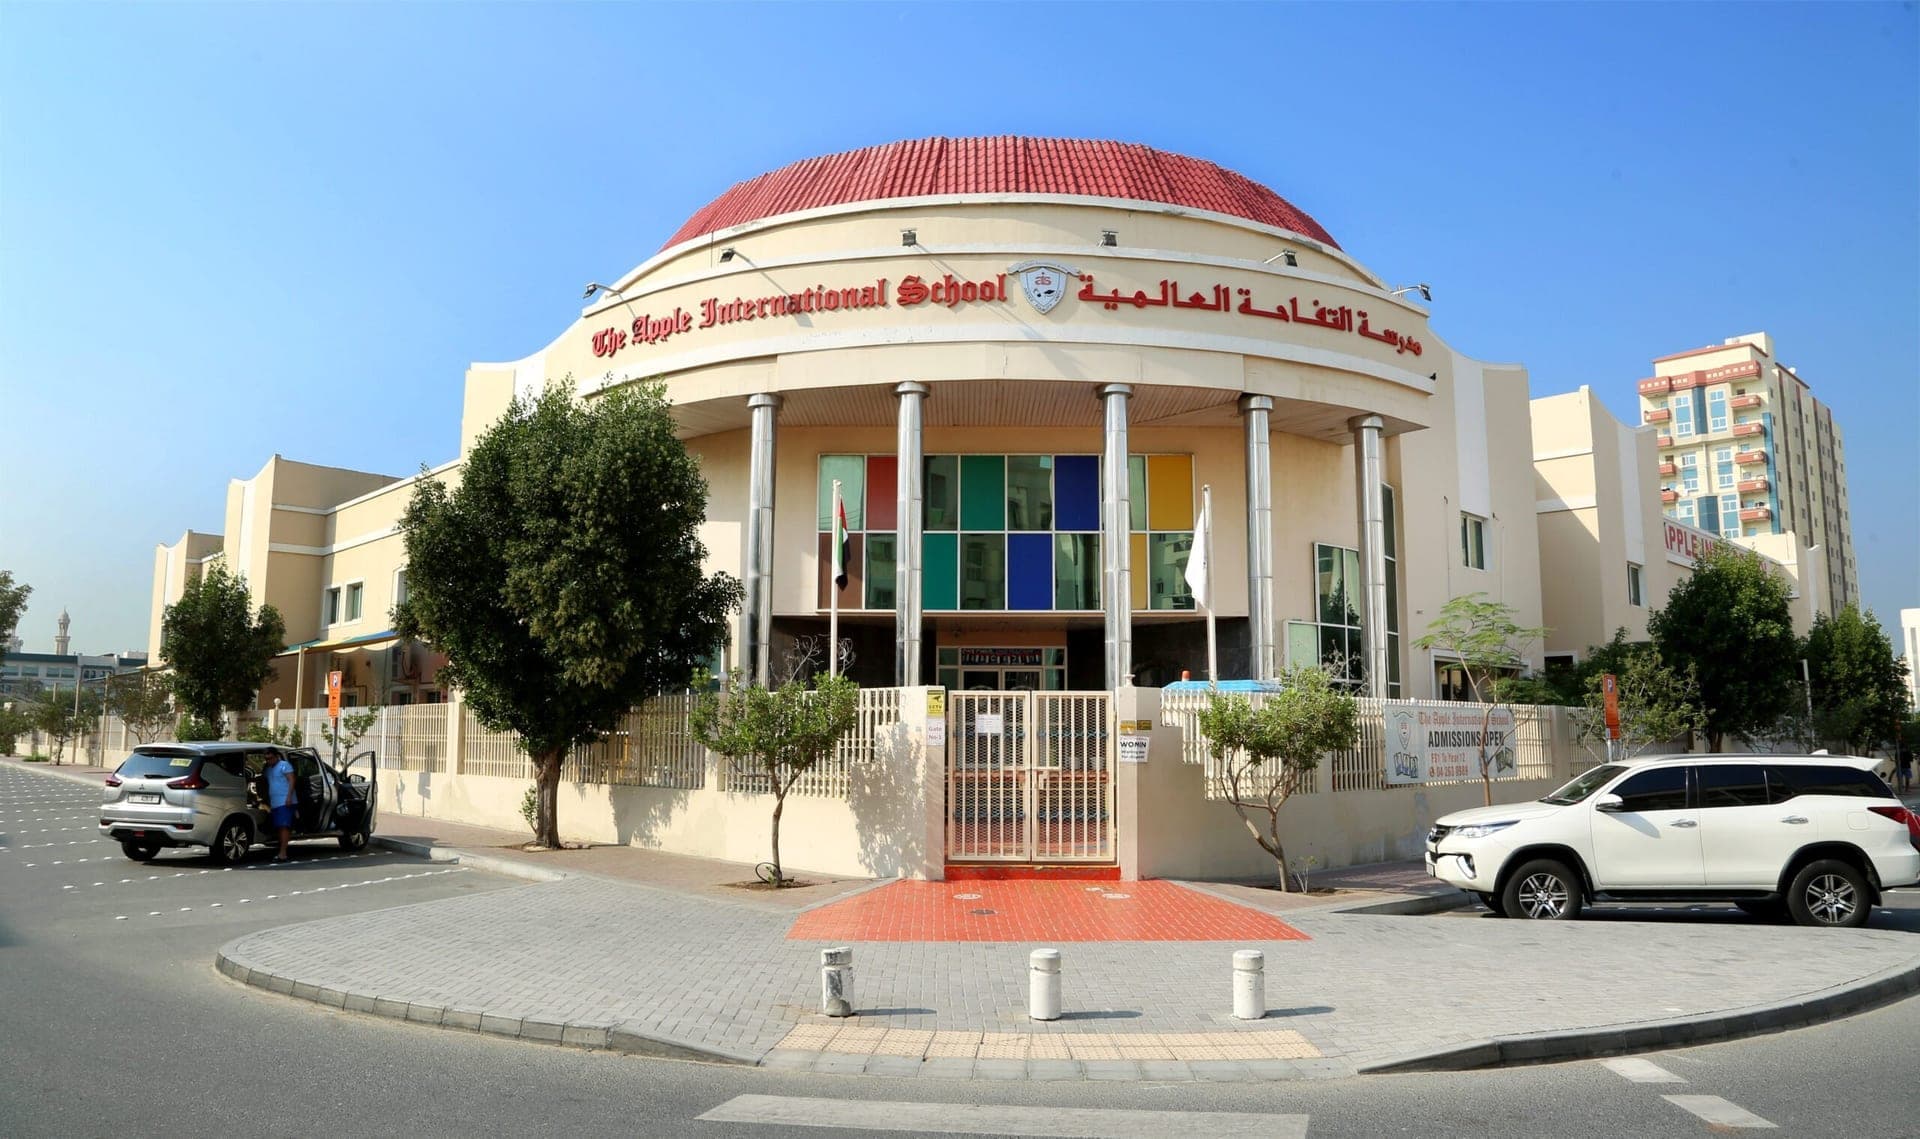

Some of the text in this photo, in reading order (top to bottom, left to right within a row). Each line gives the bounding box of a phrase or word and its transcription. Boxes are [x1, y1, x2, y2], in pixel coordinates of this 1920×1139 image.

[592, 328, 627, 357] The
[631, 309, 692, 345] Apple
[699, 278, 886, 329] International
[896, 273, 1008, 308] School
[1076, 274, 1231, 312] العالمية
[1237, 288, 1354, 332] التفاحة
[1358, 310, 1423, 356] مدرسة
[1428, 730, 1504, 748] ADMISSIONS OPEN
